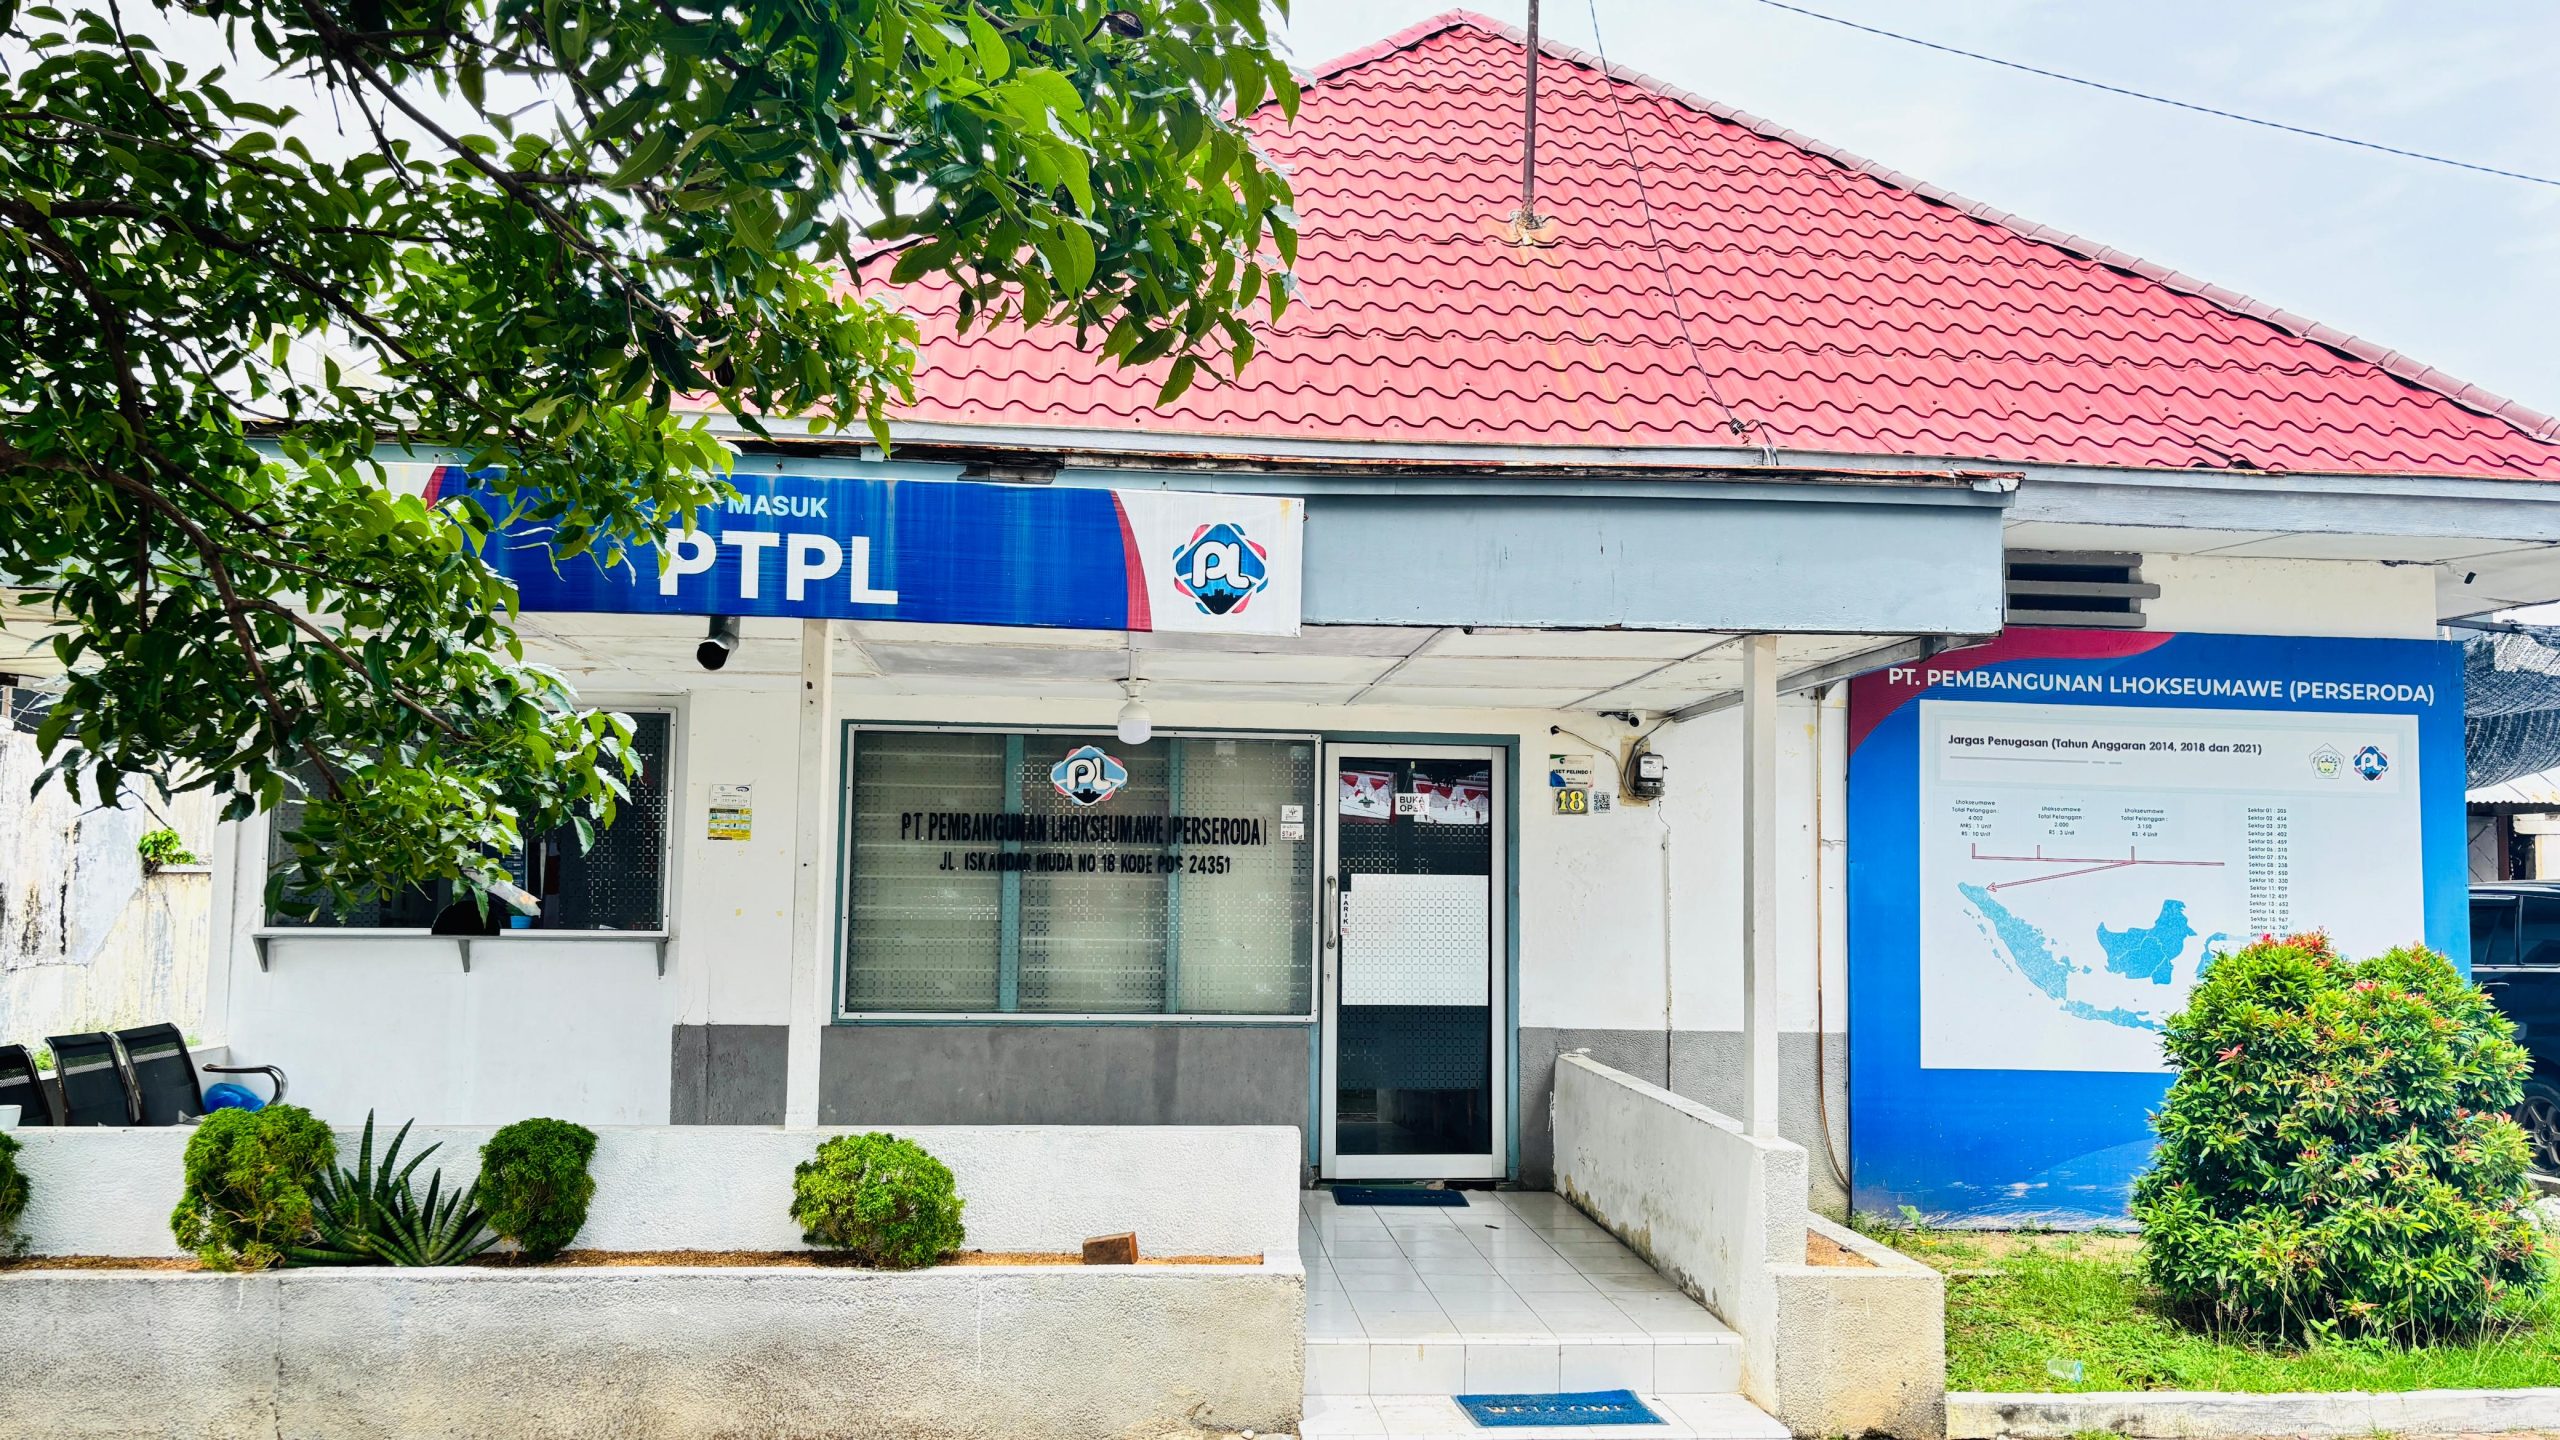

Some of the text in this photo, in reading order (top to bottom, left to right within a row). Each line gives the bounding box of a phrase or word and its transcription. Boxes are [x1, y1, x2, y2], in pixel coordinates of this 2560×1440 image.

[727, 495, 828, 518] MASUK
[659, 528, 899, 605] PTPL
[1192, 540, 1251, 589] PL
[1888, 668, 2435, 707] PT. PEMBANGUNAN LHOKSEUMAWE (PERSERODA)
[1948, 735, 2262, 756] Jargas Penugasan (Tahun Anggaran 2014, 2018 dan 2021)
[1066, 757, 1112, 790] PL
[1400, 796, 1425, 804] BUKA
[1558, 790, 1586, 812] 18
[928, 813, 1047, 842] PEMBANGUNAN
[1051, 815, 1163, 844] LHOKSEUMAWE
[1168, 816, 1266, 847] (PERSERODA)
[964, 852, 1031, 872] ISKANDAR
[1036, 853, 1073, 872] MUDA
[1101, 853, 1115, 872] 18
[1120, 854, 1152, 873] KODE
[1158, 855, 1183, 873] POS
[1189, 855, 1230, 874] 24351
